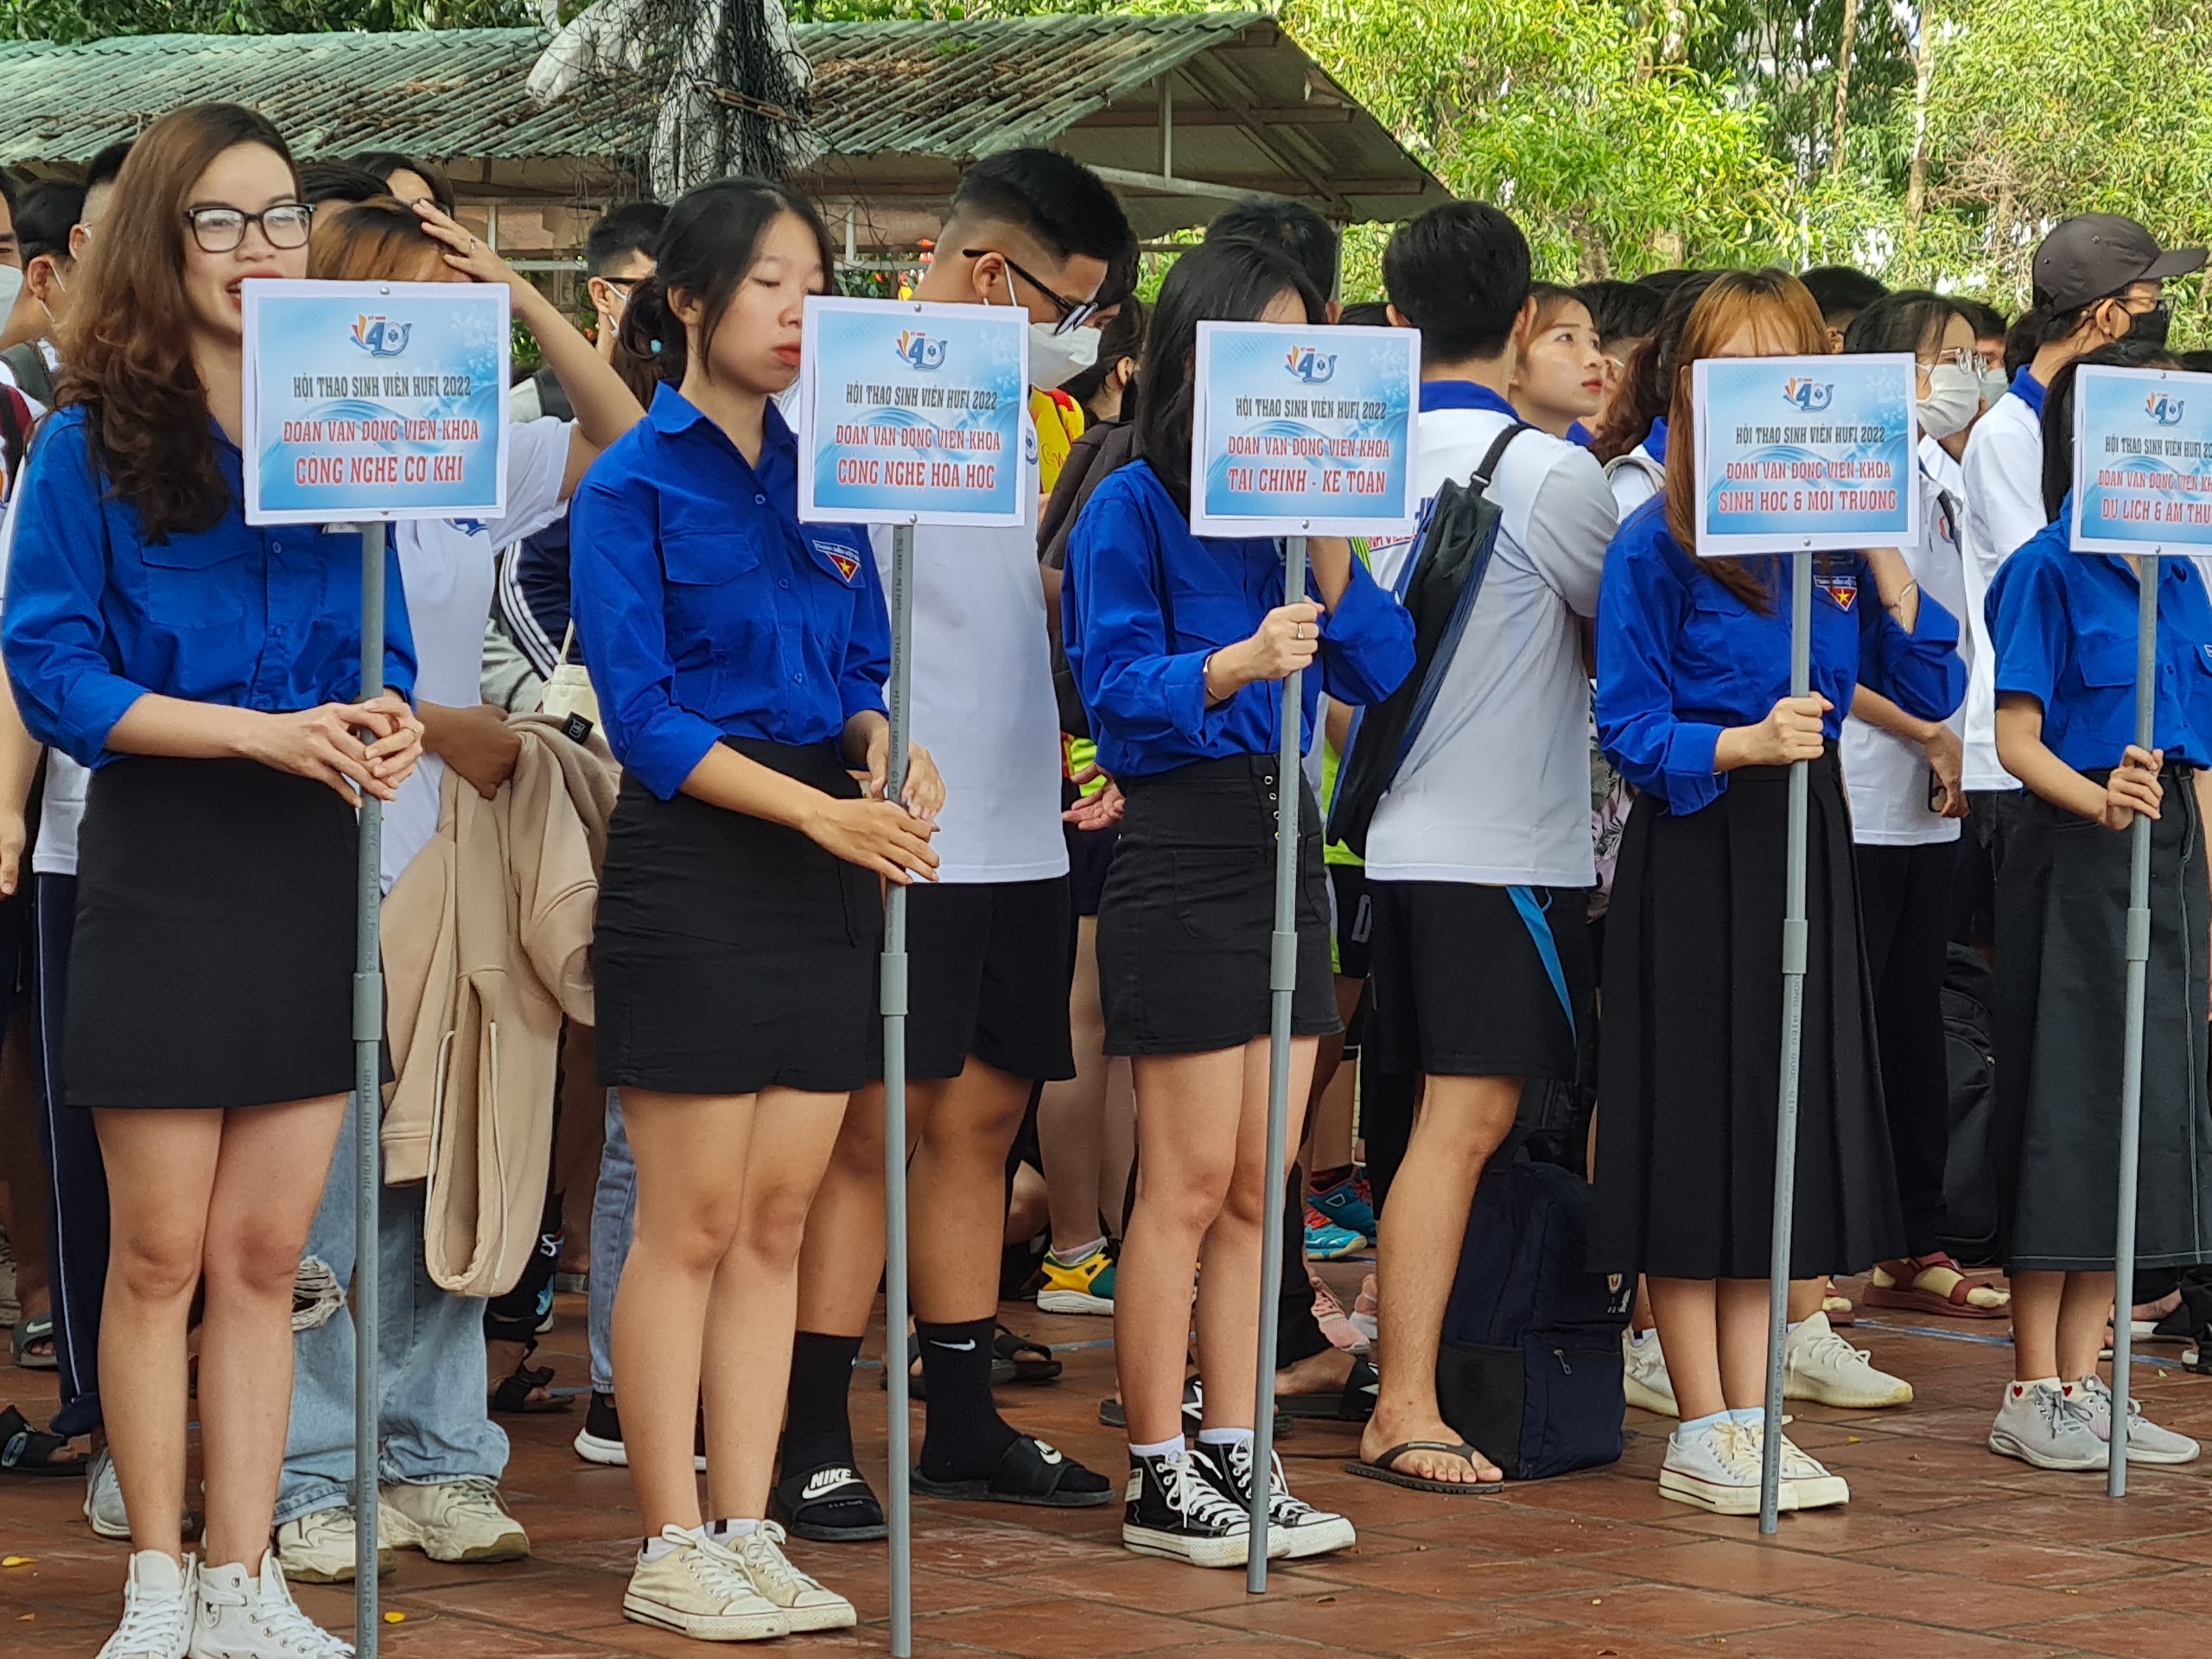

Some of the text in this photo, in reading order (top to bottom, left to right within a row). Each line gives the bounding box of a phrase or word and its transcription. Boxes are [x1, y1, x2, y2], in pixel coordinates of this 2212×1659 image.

[294, 372, 313, 402] HỘI
[353, 376, 379, 397] SINH
[383, 372, 409, 397] VIÊN
[413, 376, 440, 397] HUFI
[443, 376, 471, 397] 2022
[894, 386, 918, 407] SINH
[946, 389, 969, 410] HUFI
[972, 391, 998, 410] 2022
[1284, 399, 1308, 418] SINH
[1338, 400, 1359, 420] HUFI
[1362, 402, 1388, 420] 2022
[442, 419, 479, 441] KHOA
[969, 430, 1001, 451] KHOA
[1783, 426, 1807, 444] SINH
[1835, 426, 1858, 443] HUFI
[1860, 426, 1885, 443] 2022
[1359, 439, 1389, 458] KHOA
[2144, 438, 2163, 455] SINH
[2183, 440, 2202, 458] HUFI
[2203, 442, 2212, 459] 20
[296, 451, 343, 485] CÔNG
[433, 448, 463, 481] KHÍ
[838, 453, 879, 485] CÔNG
[1859, 461, 1891, 479] KHOA
[1719, 491, 1754, 512] SINH
[1794, 491, 1802, 512] &
[2154, 501, 2162, 521] &
[810, 1468, 852, 1490] NIKE
